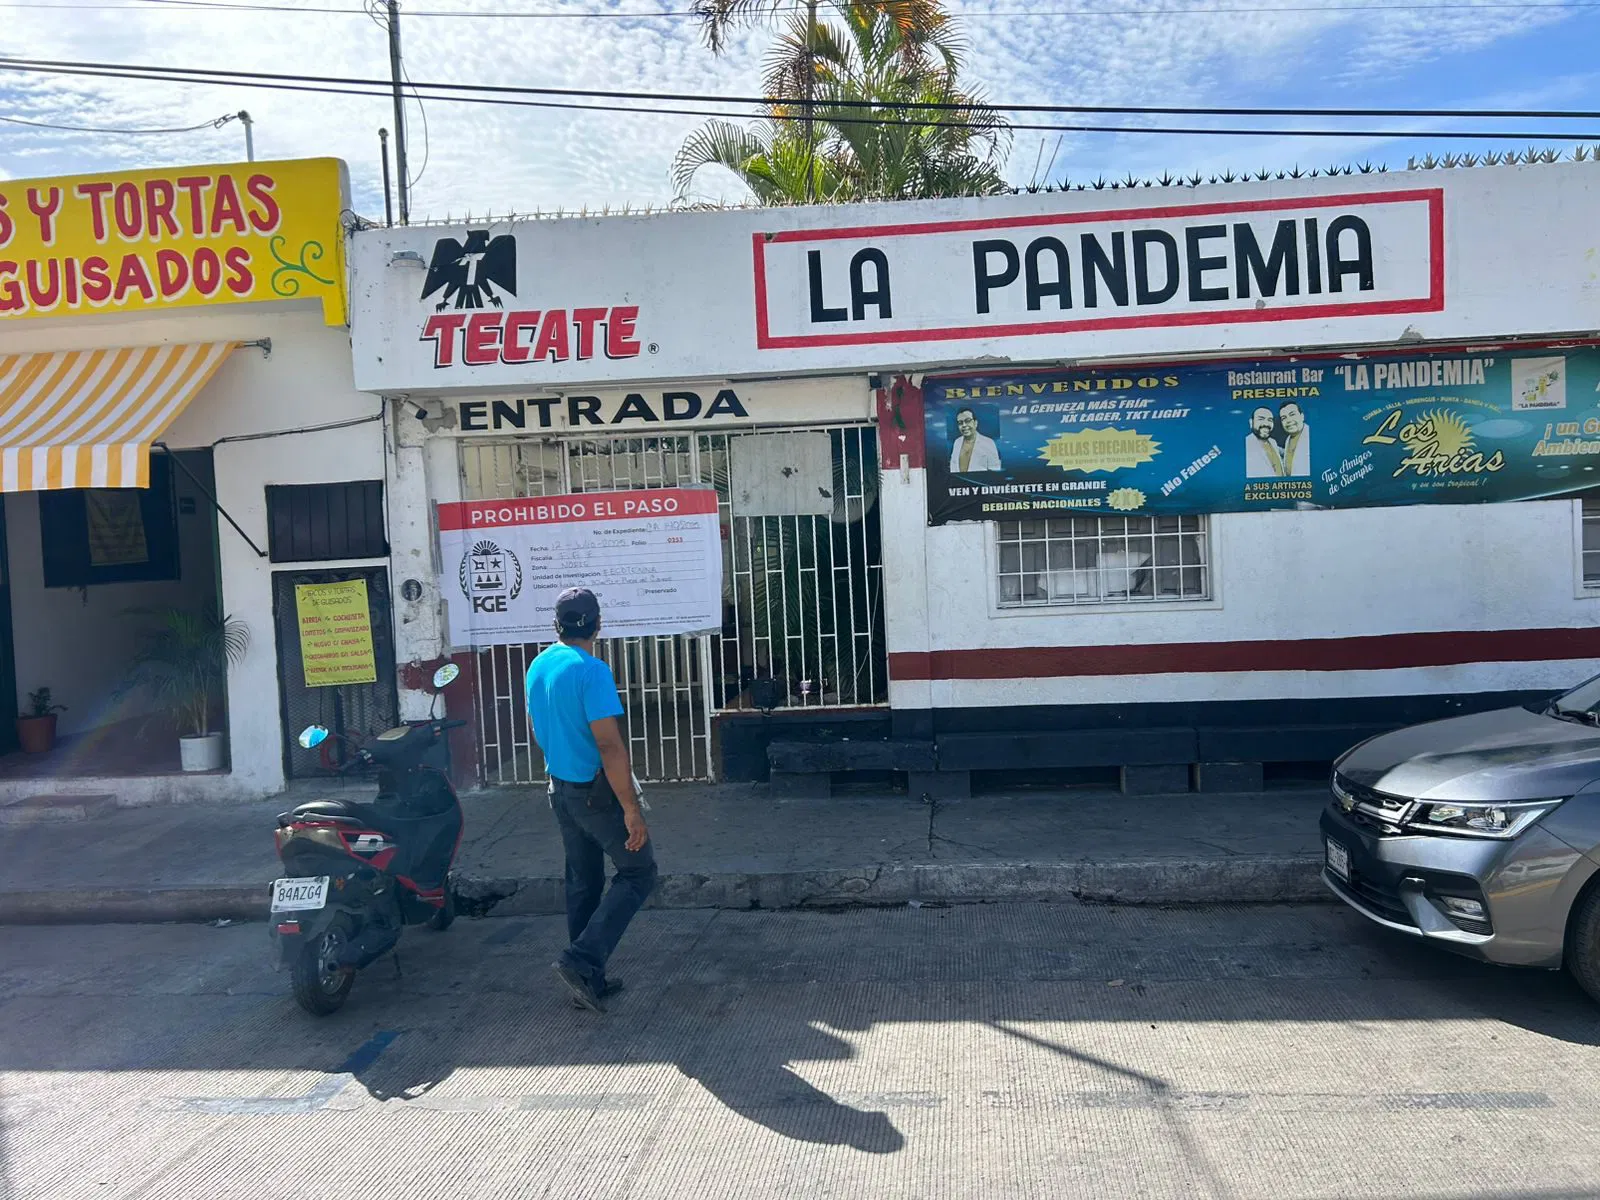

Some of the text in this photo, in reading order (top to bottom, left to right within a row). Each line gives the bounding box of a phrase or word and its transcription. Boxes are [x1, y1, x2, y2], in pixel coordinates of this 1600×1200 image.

[26, 186, 61, 243] Y
[76, 173, 281, 243] TORTAS
[808, 214, 1374, 322] LA PANDEMIA
[0, 246, 254, 313] GUISADOS
[420, 304, 641, 370] TECATE
[1228, 367, 1324, 386] Restaurant Bar
[944, 375, 1180, 399] BIENVENIDOS
[1232, 386, 1320, 399] PRESENTA
[459, 388, 749, 432] ENTRADA
[1012, 404, 1027, 415] LA
[1030, 401, 1085, 414] CERVEZA
[1061, 408, 1190, 424] XX LAGER, TKT LIGHT
[1363, 409, 1438, 445] Los
[1556, 421, 1579, 436] un
[1583, 417, 1600, 434] G
[1051, 439, 1149, 456] BELLAS EDECANES
[1321, 450, 1373, 485] Tus Amigos
[1392, 440, 1506, 478] Arias
[1160, 444, 1222, 497] ¡No Faltes!
[1328, 462, 1375, 496] de Siempre
[948, 480, 1107, 497] VEN Y DIVIÉRTETE EN GRANDE
[1244, 480, 1312, 491] A SUS ARTISTAS
[1432, 480, 1445, 488] son
[1447, 478, 1479, 489] tropical
[981, 498, 1102, 512] BEBIDAS NACIONALES
[1244, 490, 1312, 501] EXCLUSIVOS
[471, 497, 679, 525] PROHIBIDO EL PASO
[645, 587, 678, 595] Preservado
[473, 595, 508, 614] FGE
